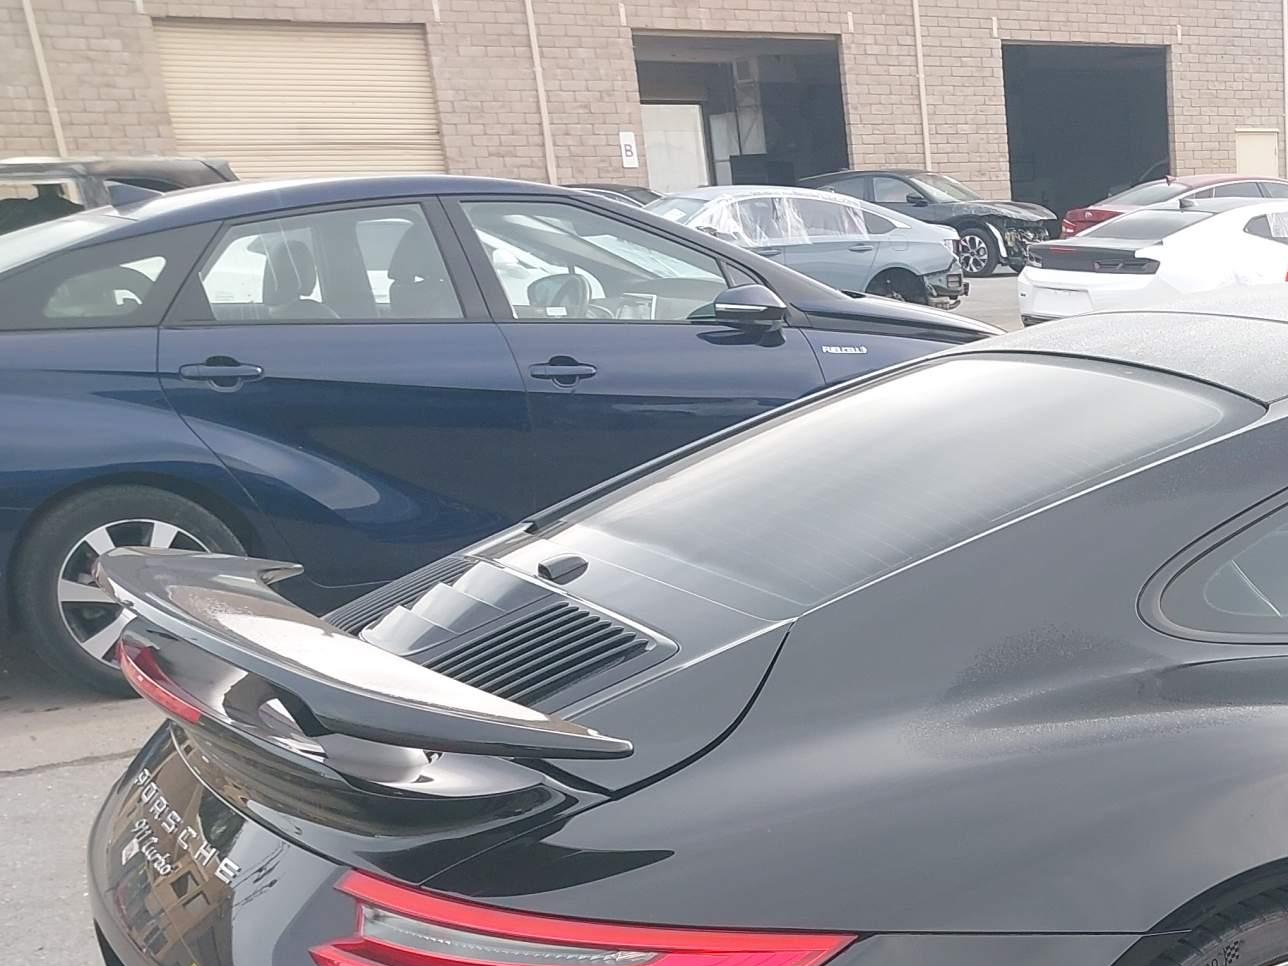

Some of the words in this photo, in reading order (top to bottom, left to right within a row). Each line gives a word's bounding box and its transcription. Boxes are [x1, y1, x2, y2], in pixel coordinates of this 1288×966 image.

[623, 143, 634, 158] B
[130, 818, 154, 842] 911
[142, 836, 172, 876] Turbo
[134, 768, 241, 885] PORSCHE
